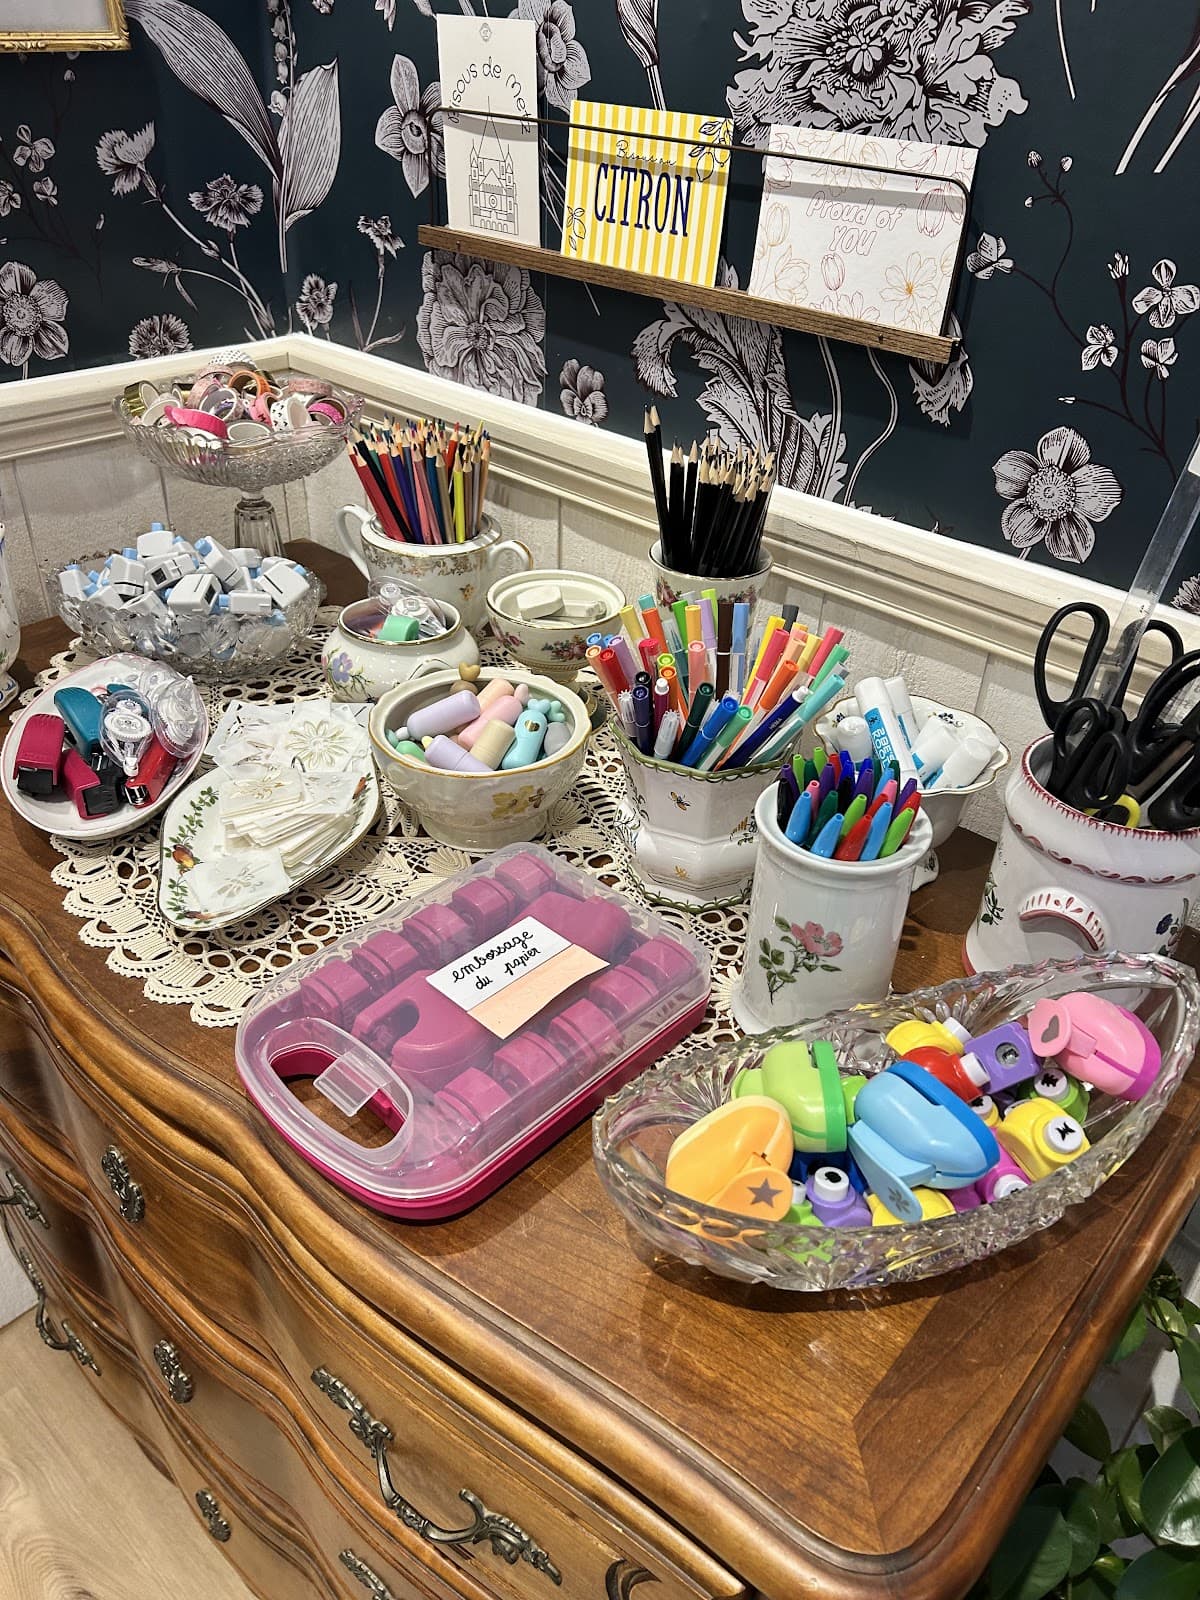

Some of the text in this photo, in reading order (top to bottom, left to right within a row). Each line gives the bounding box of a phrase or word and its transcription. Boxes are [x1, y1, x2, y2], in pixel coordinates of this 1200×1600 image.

[482, 55, 502, 79] de
[594, 162, 694, 237] CITRON
[806, 190, 907, 232] Proud of
[829, 225, 878, 257] YOU
[452, 930, 534, 983] embossage
[475, 945, 541, 990] du papier
